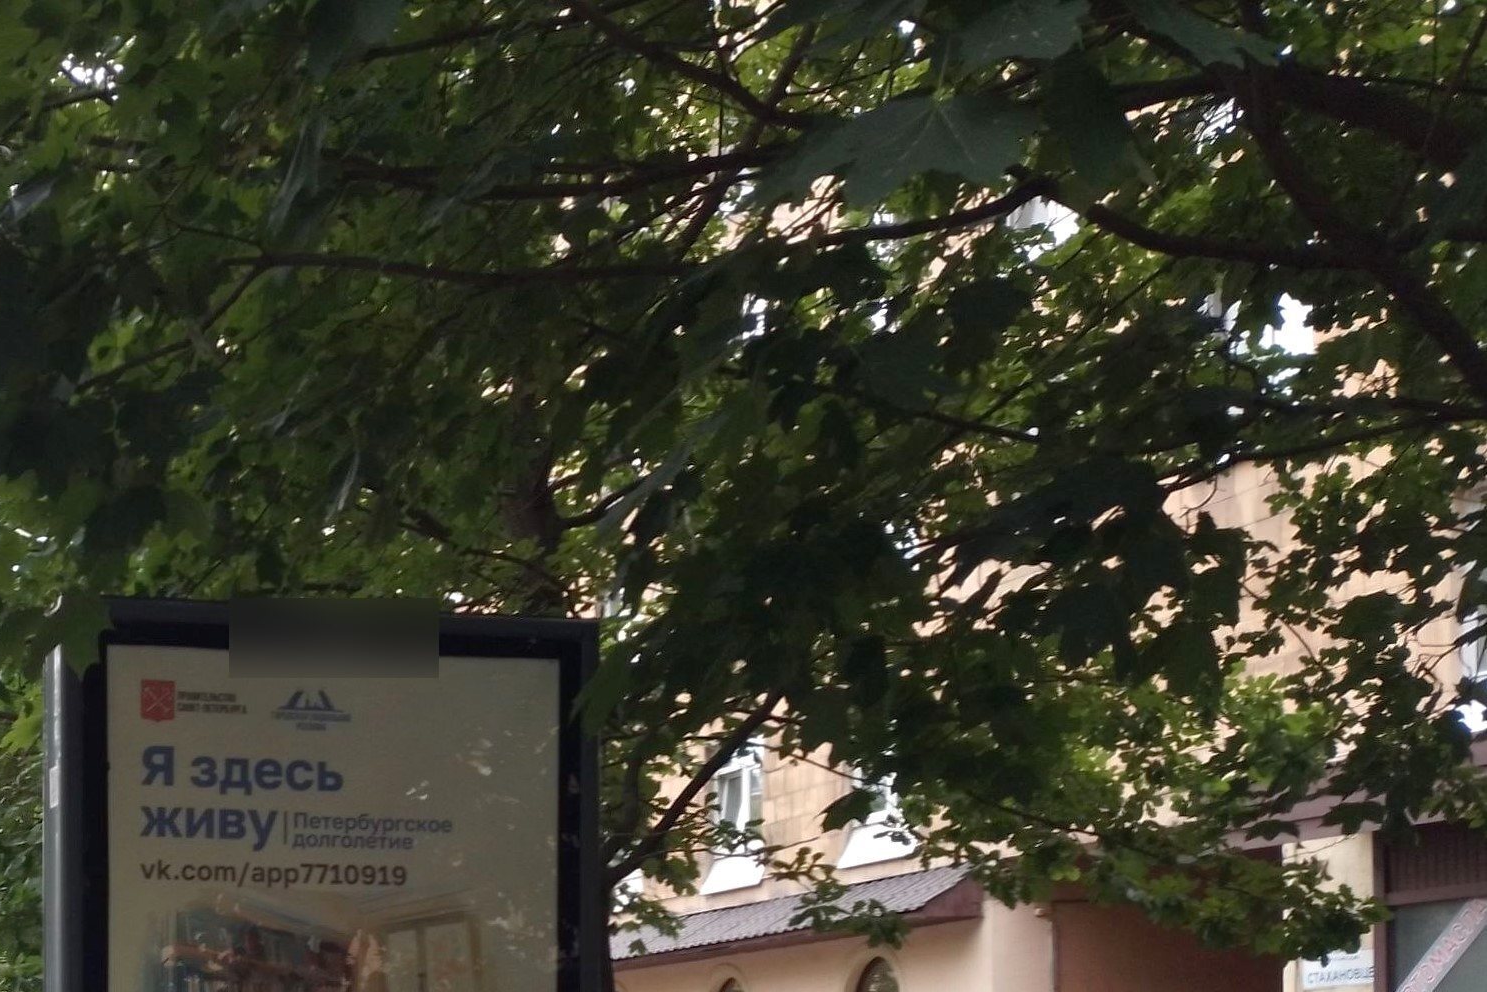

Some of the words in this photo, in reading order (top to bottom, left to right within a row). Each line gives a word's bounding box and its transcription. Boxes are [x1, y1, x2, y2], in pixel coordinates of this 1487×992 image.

[141, 745, 175, 787] Я
[189, 755, 345, 796] здесь
[139, 805, 279, 851] живу
[292, 811, 453, 836] Петербургское
[291, 831, 414, 850] долголетие
[139, 859, 408, 888] vk.com/app7710919
[1307, 965, 1375, 985] СТАХАНОВЦЕ
